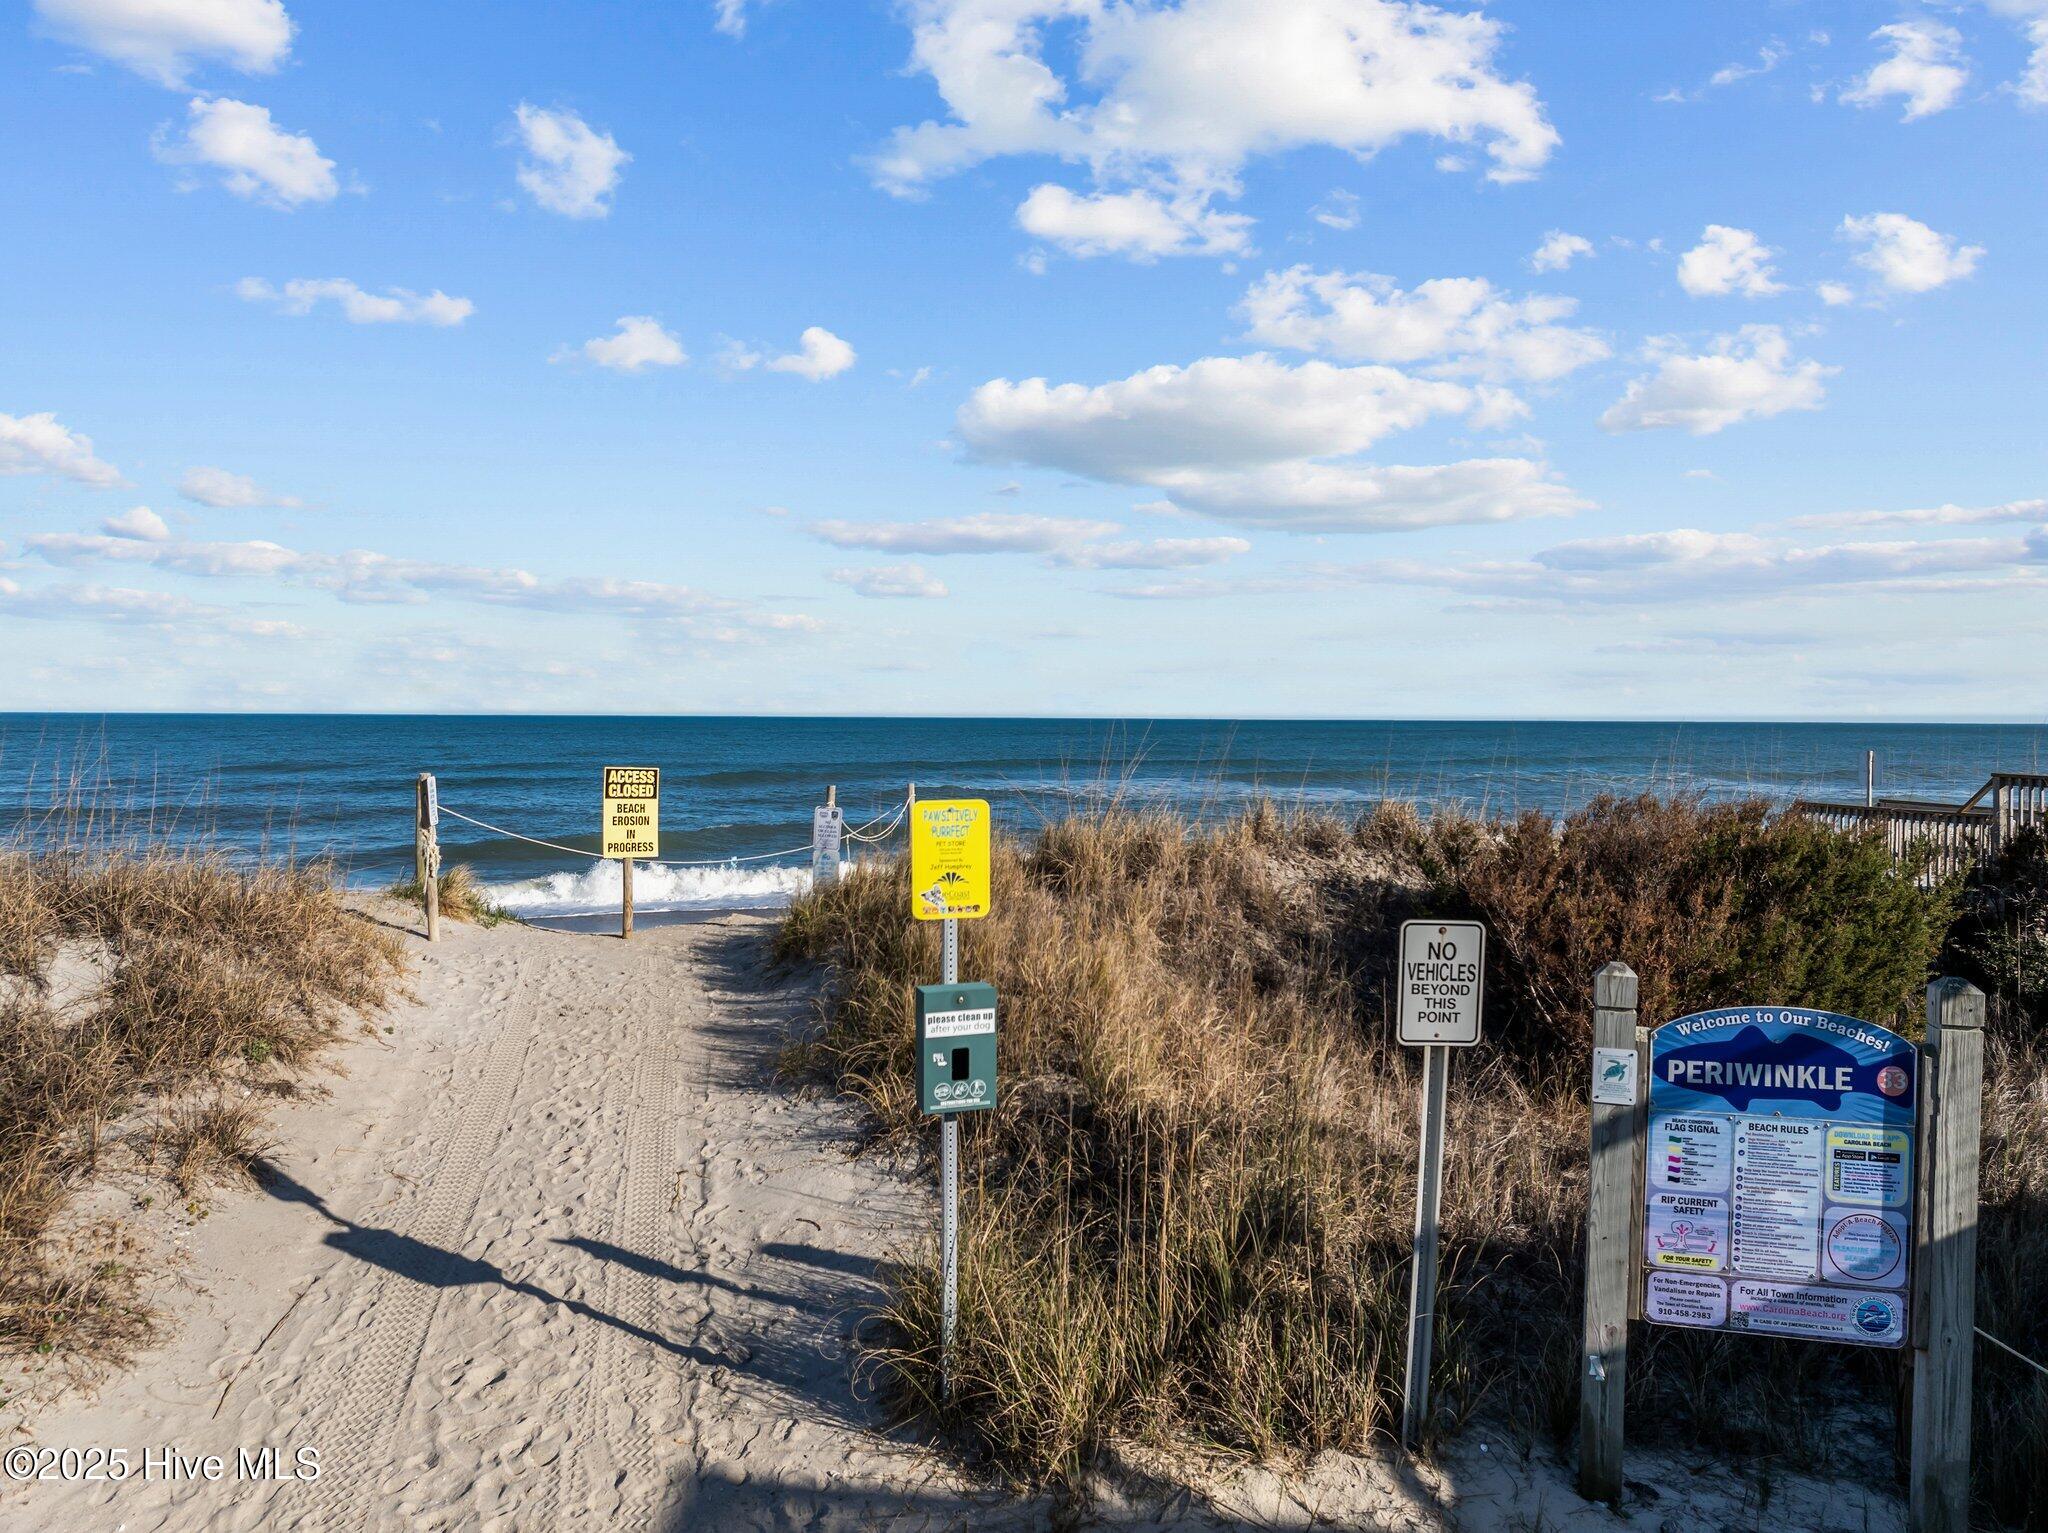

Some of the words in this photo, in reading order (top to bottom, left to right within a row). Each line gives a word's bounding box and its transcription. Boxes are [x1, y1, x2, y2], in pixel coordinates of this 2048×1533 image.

[608, 770, 655, 783] ACCESS
[608, 784, 654, 797] CLOSED
[617, 804, 645, 813] BEACH
[924, 808, 978, 821] PAWSITIVELY
[612, 816, 650, 825] EROSION
[627, 830, 635, 839] IN
[931, 825, 970, 838] PURRFECT
[608, 842, 653, 852] PROGRESS
[1428, 942, 1457, 961] NO
[1408, 962, 1476, 982] VEHICLES
[1411, 984, 1470, 995] BEYOND
[1424, 998, 1456, 1010] THIS
[927, 1014, 956, 1025] please
[958, 1013, 981, 1022] clean
[983, 1012, 994, 1020] up
[1418, 1012, 1461, 1023] POINT
[930, 1024, 950, 1034] after
[952, 1024, 971, 1033] your
[974, 1021, 991, 1031] dog
[1676, 1012, 1751, 1036] Welcome
[1756, 1010, 1774, 1023] to
[1779, 1011, 1812, 1027] Our
[1815, 1016, 1891, 1052] Beaches!
[1667, 1059, 1853, 1091] PERIWINKLE
[1881, 1069, 1907, 1090] 33
[1665, 1123, 1686, 1131] FLAG
[1688, 1124, 1720, 1134] SIGNAL
[1748, 1123, 1778, 1132] BEACH
[1780, 1126, 1809, 1134] RULES
[1661, 1196, 1675, 1204] RIP
[1678, 1197, 1718, 1207] CURRENT
[1674, 1206, 1705, 1215] SAFETY
[1877, 1220, 1897, 1244] Program
[1654, 1286, 1686, 1294] Vandalism
[1665, 1279, 1722, 1290] Non-Emergencies,
[1740, 1287, 1755, 1295] For
[1772, 1289, 1794, 1299] Town
[1796, 1292, 1847, 1304] Information
[1658, 1308, 1711, 1320] 910-458-2983
[1739, 1304, 1847, 1321] www.CarolinaBeach.org
